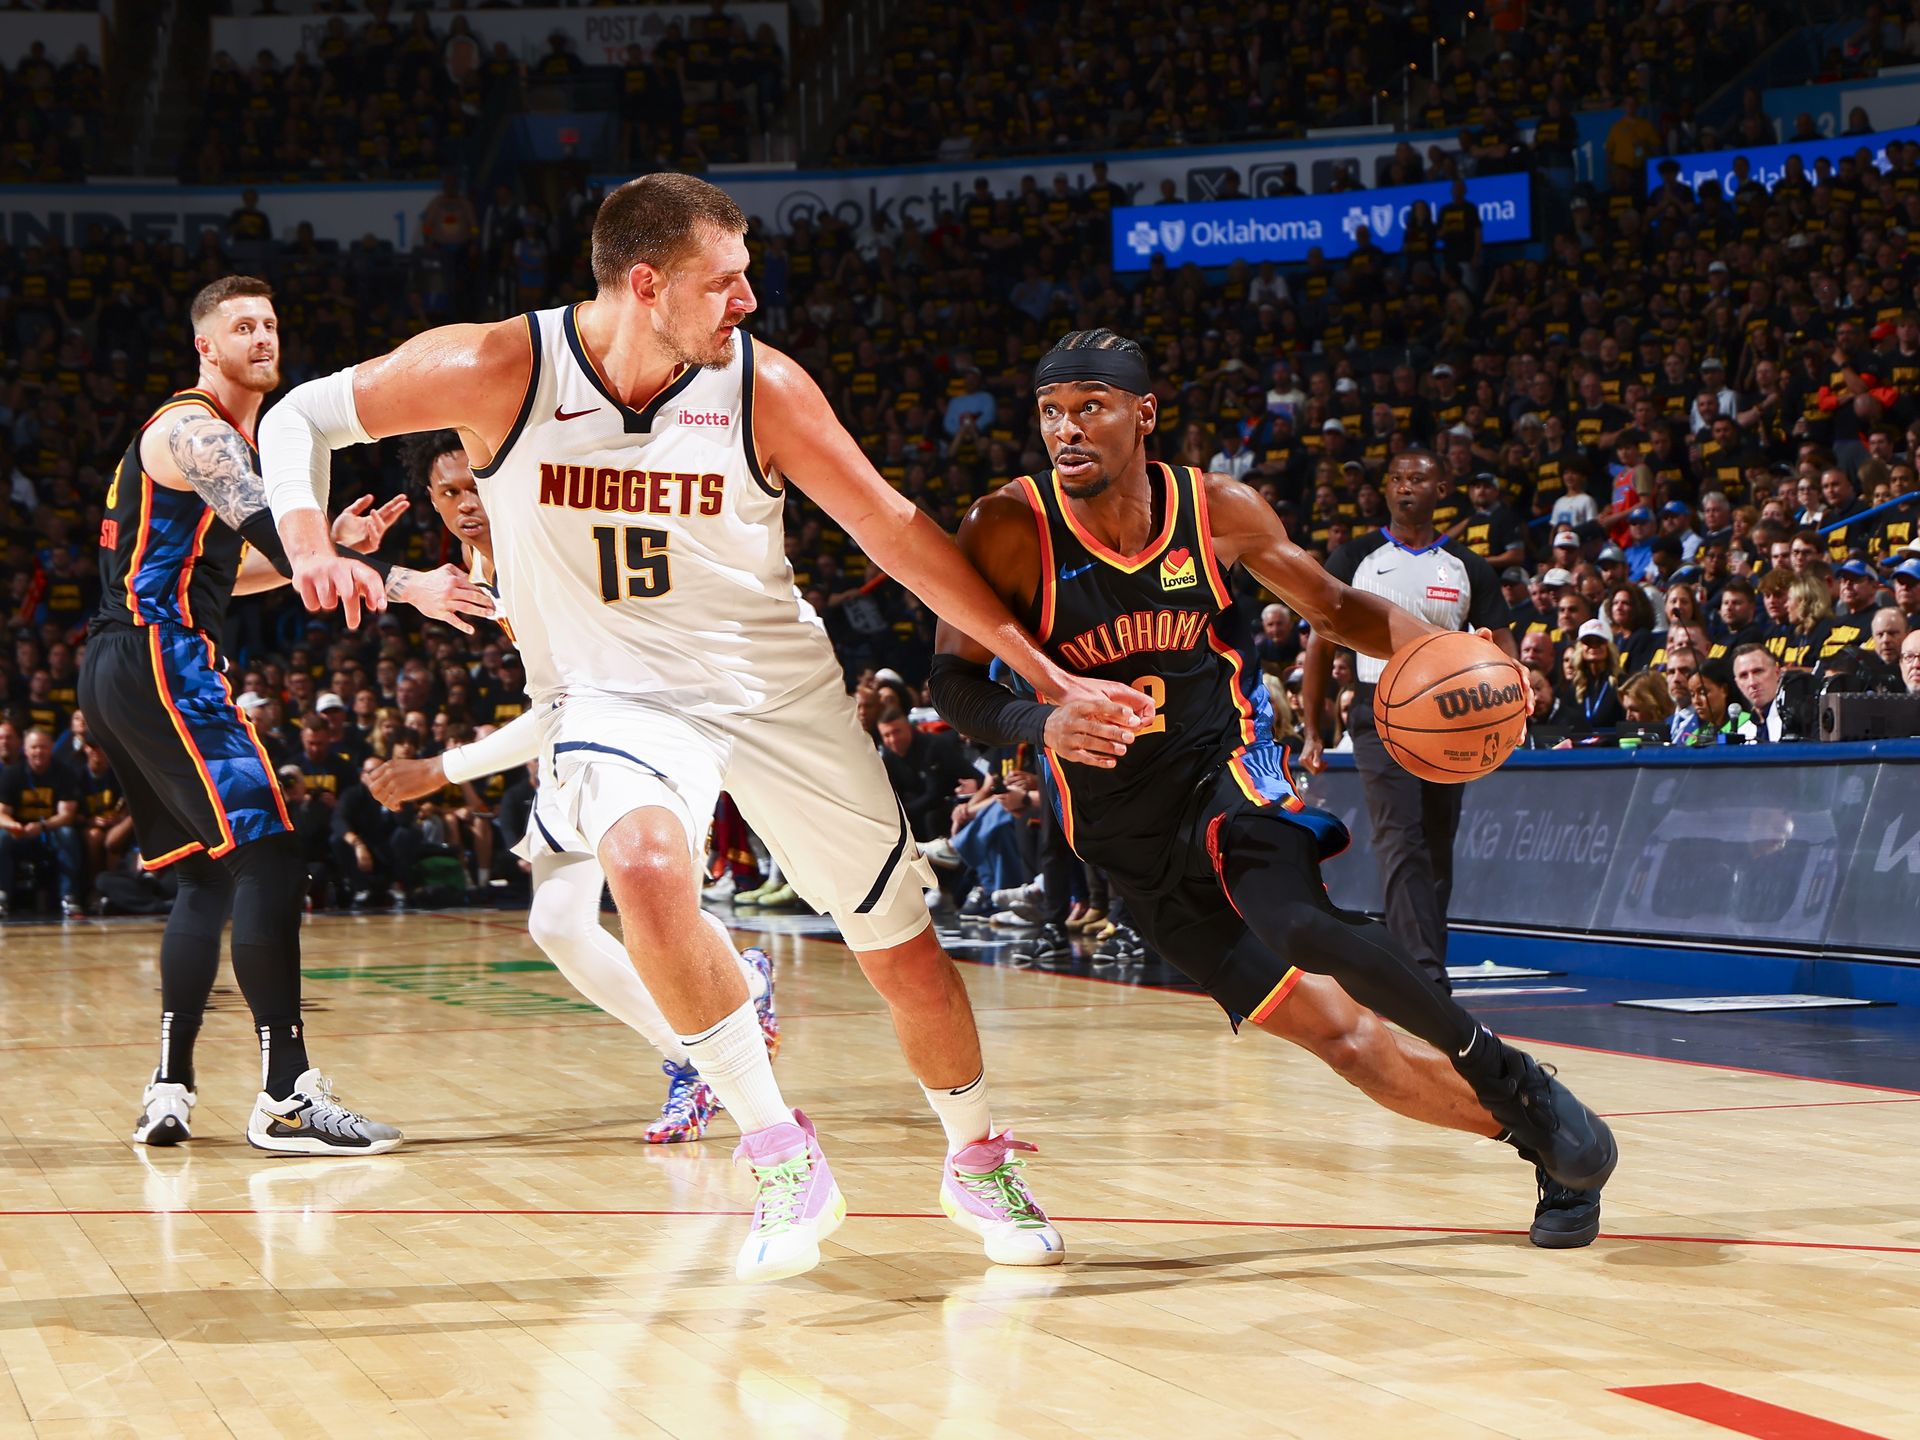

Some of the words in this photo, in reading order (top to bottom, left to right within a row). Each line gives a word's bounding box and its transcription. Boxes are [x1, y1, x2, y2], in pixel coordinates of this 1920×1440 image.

[1190, 218, 1323, 247] Oklahoma
[678, 410, 730, 427] ibotta
[537, 461, 726, 518] NUGGETS
[591, 524, 674, 605] 15
[1130, 674, 1167, 737] 2
[1433, 680, 1524, 721] Wilson
[1462, 809, 1500, 860] Kia
